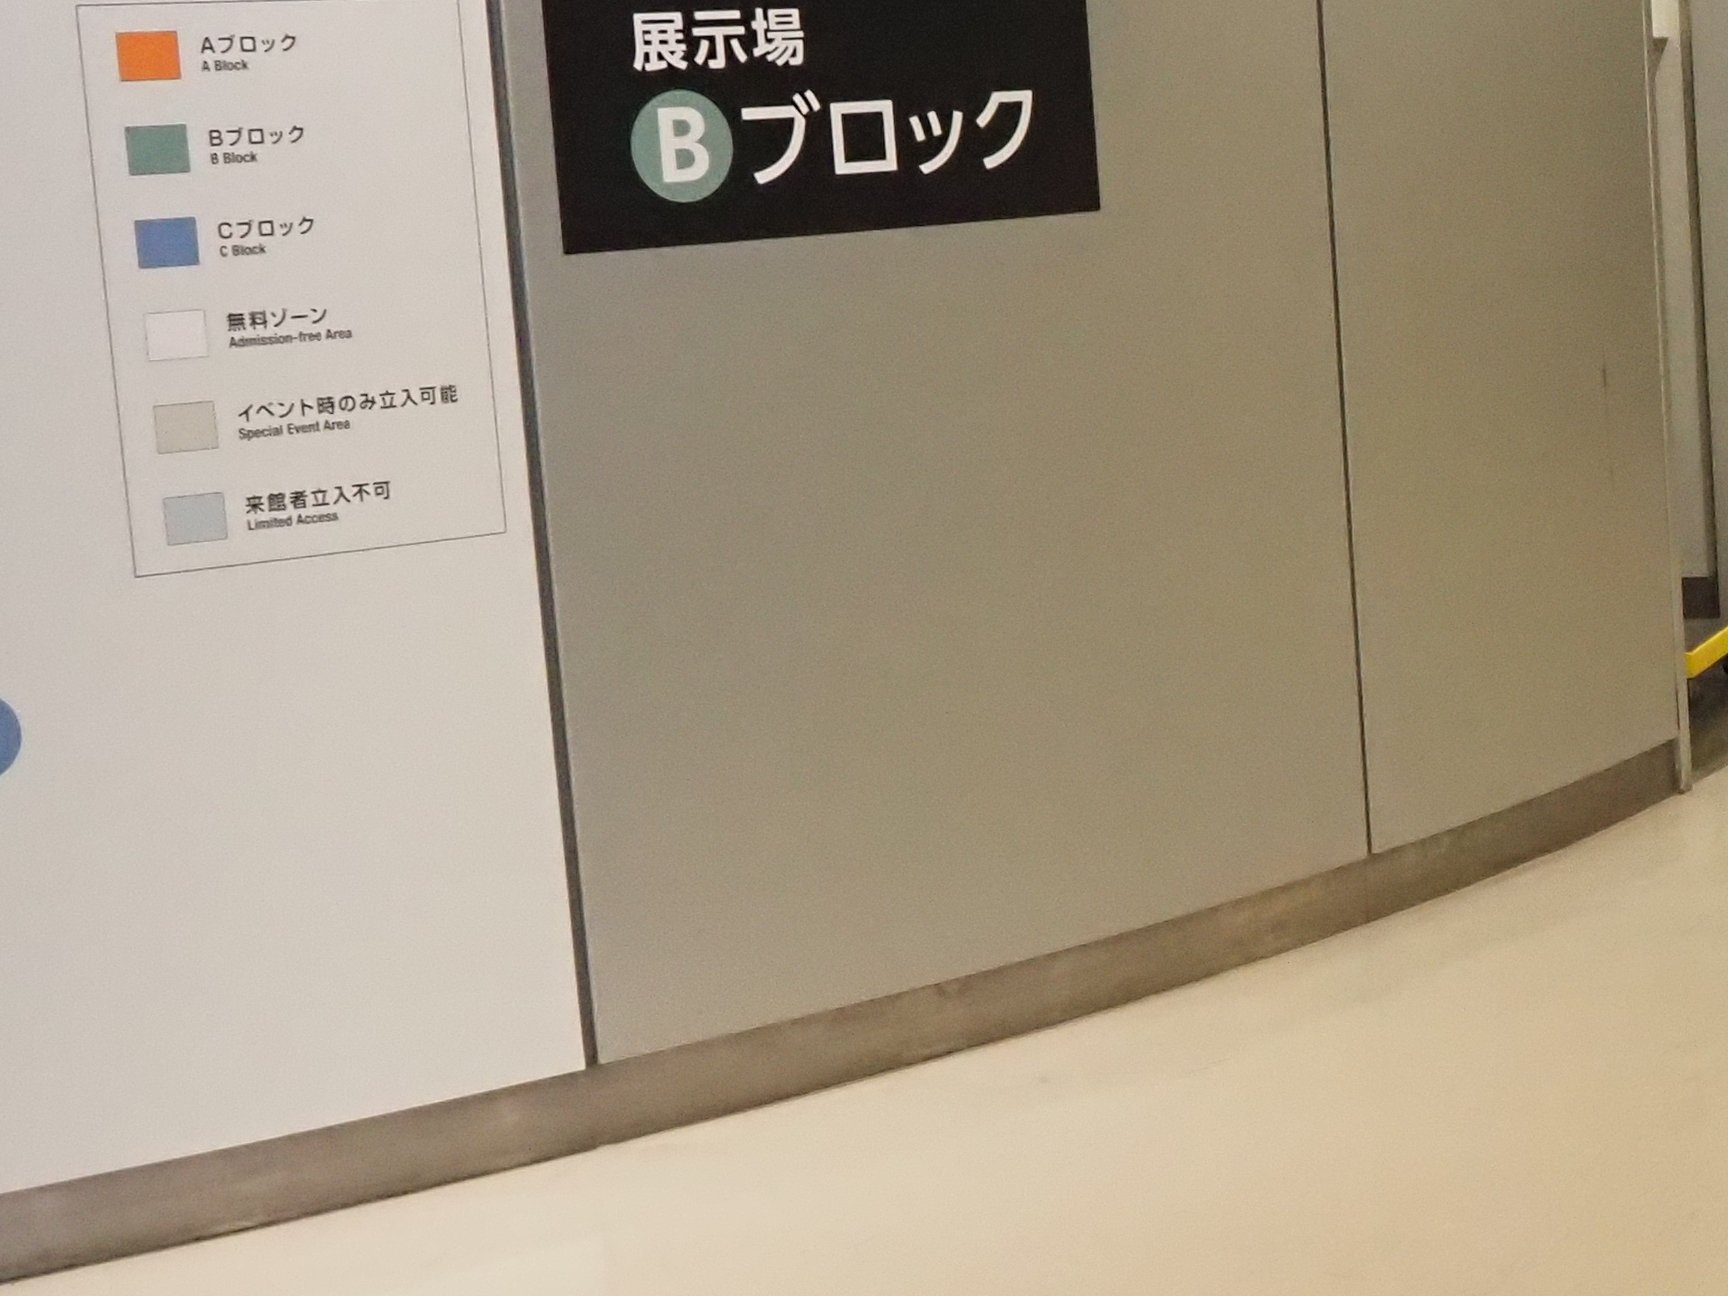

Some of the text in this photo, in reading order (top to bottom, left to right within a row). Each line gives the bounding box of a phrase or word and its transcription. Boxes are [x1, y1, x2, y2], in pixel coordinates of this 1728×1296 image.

[200, 32, 299, 55] Aブロック
[631, 7, 806, 72] 展示場
[201, 58, 250, 72] A Block
[208, 124, 306, 147] Bブロック
[654, 89, 1034, 186] Bブロック
[210, 150, 258, 165] B Block
[217, 216, 316, 240] Cブロック
[219, 242, 267, 258] C Block
[226, 308, 329, 332] 無料ゾーン
[228, 326, 353, 348] Admission-free Area
[237, 383, 459, 422] イベント時のみ立入可能
[237, 417, 351, 441] Special Event Area
[245, 480, 392, 516] 来館者立入不可
[247, 510, 340, 531] Limited Access
